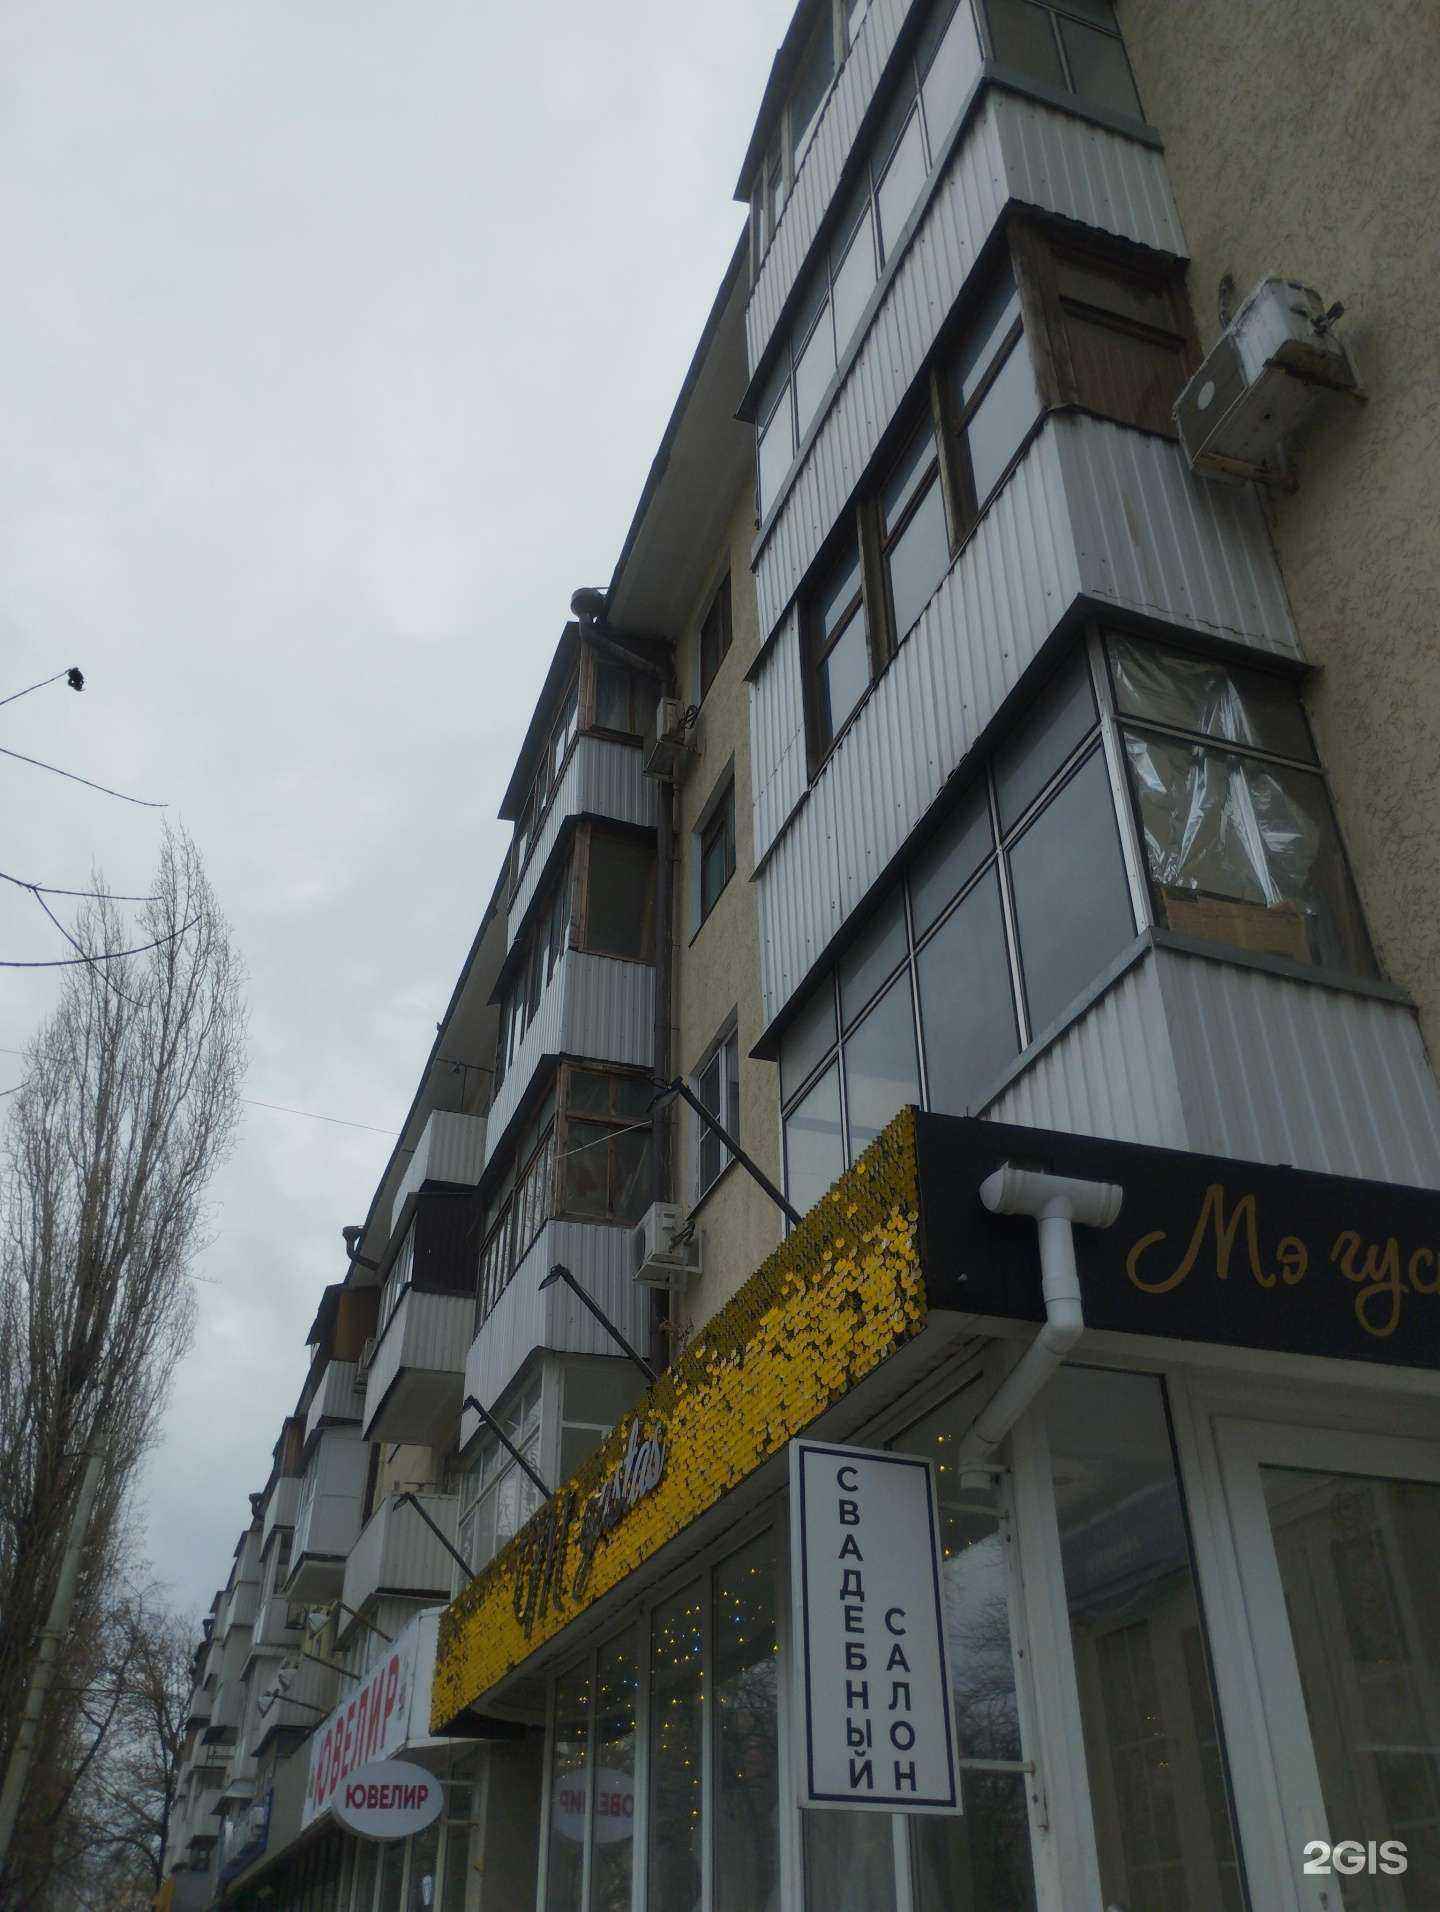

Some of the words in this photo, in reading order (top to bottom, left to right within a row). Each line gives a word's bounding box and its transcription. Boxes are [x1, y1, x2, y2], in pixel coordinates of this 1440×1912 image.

[836, 1466, 874, 1790] СВАДЕБНЫЙ
[885, 1607, 917, 1791] САЛОН
[345, 1784, 429, 1810] ЮВЕЛИР
